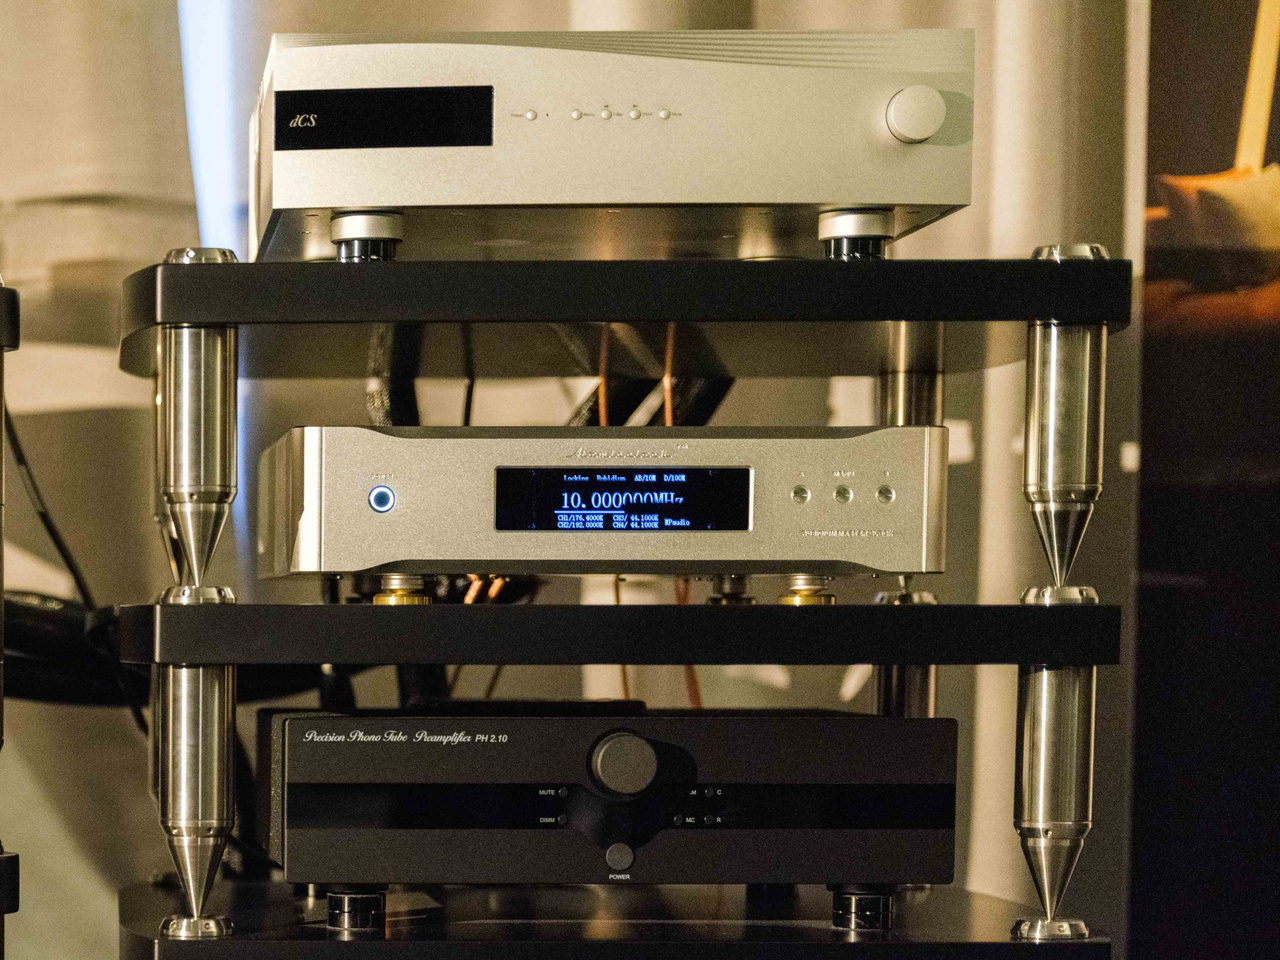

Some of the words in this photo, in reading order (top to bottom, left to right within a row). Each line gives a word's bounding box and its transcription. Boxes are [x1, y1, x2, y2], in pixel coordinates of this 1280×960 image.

[289, 113, 318, 128] dCS
[303, 730, 346, 742] Precision
[347, 730, 382, 742] Phono
[383, 730, 408, 742] Tube
[413, 730, 472, 745] Preamplifier
[475, 735, 488, 743] PH
[489, 735, 508, 743] 2.10
